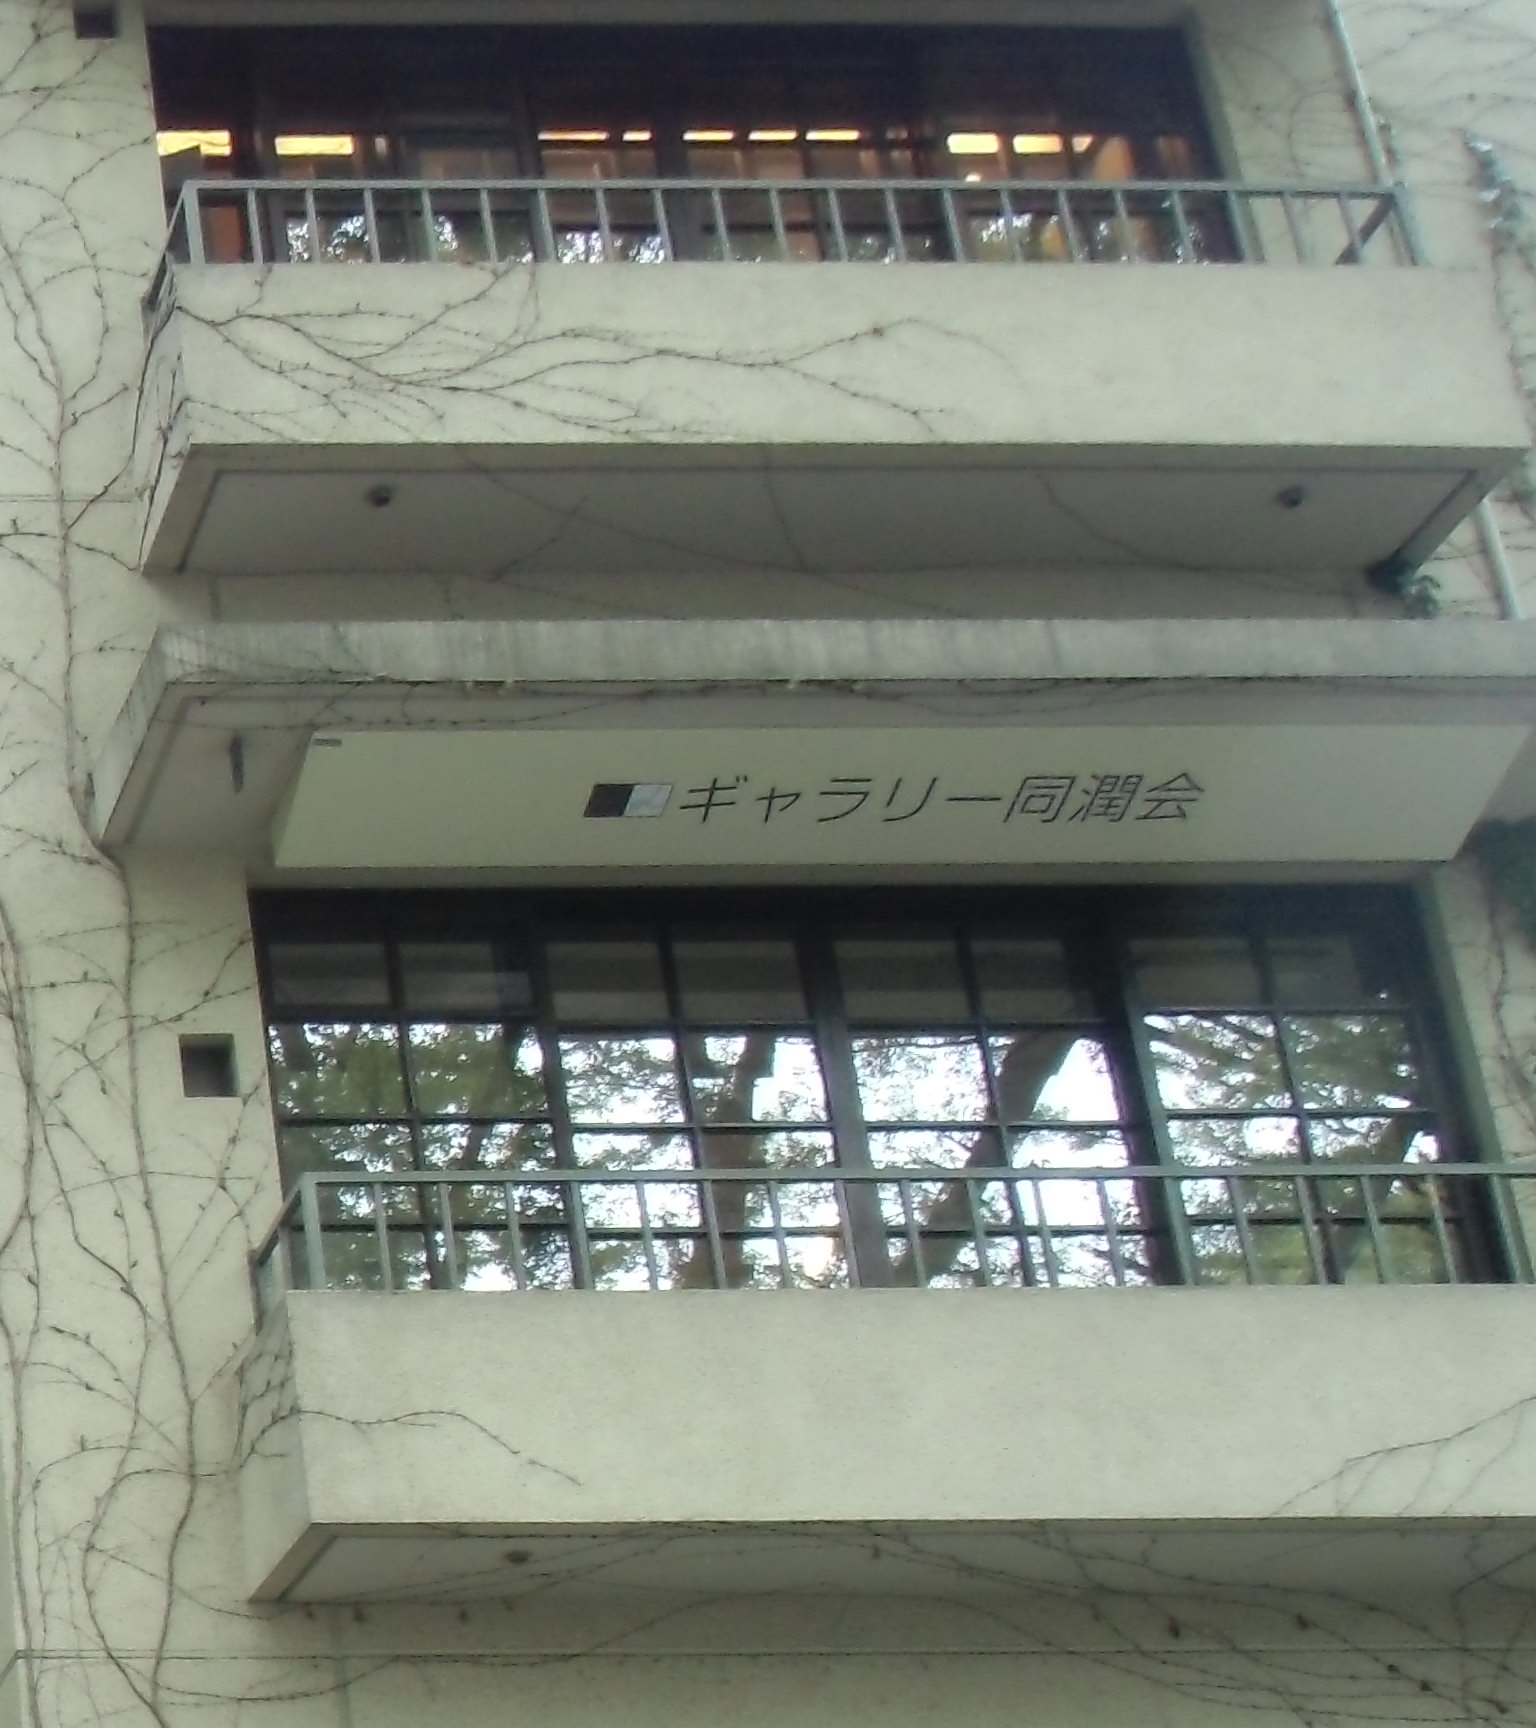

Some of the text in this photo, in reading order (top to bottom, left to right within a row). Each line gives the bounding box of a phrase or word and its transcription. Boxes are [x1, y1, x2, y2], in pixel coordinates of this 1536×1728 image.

[679, 773, 1205, 823] ギャラリー同潤会
